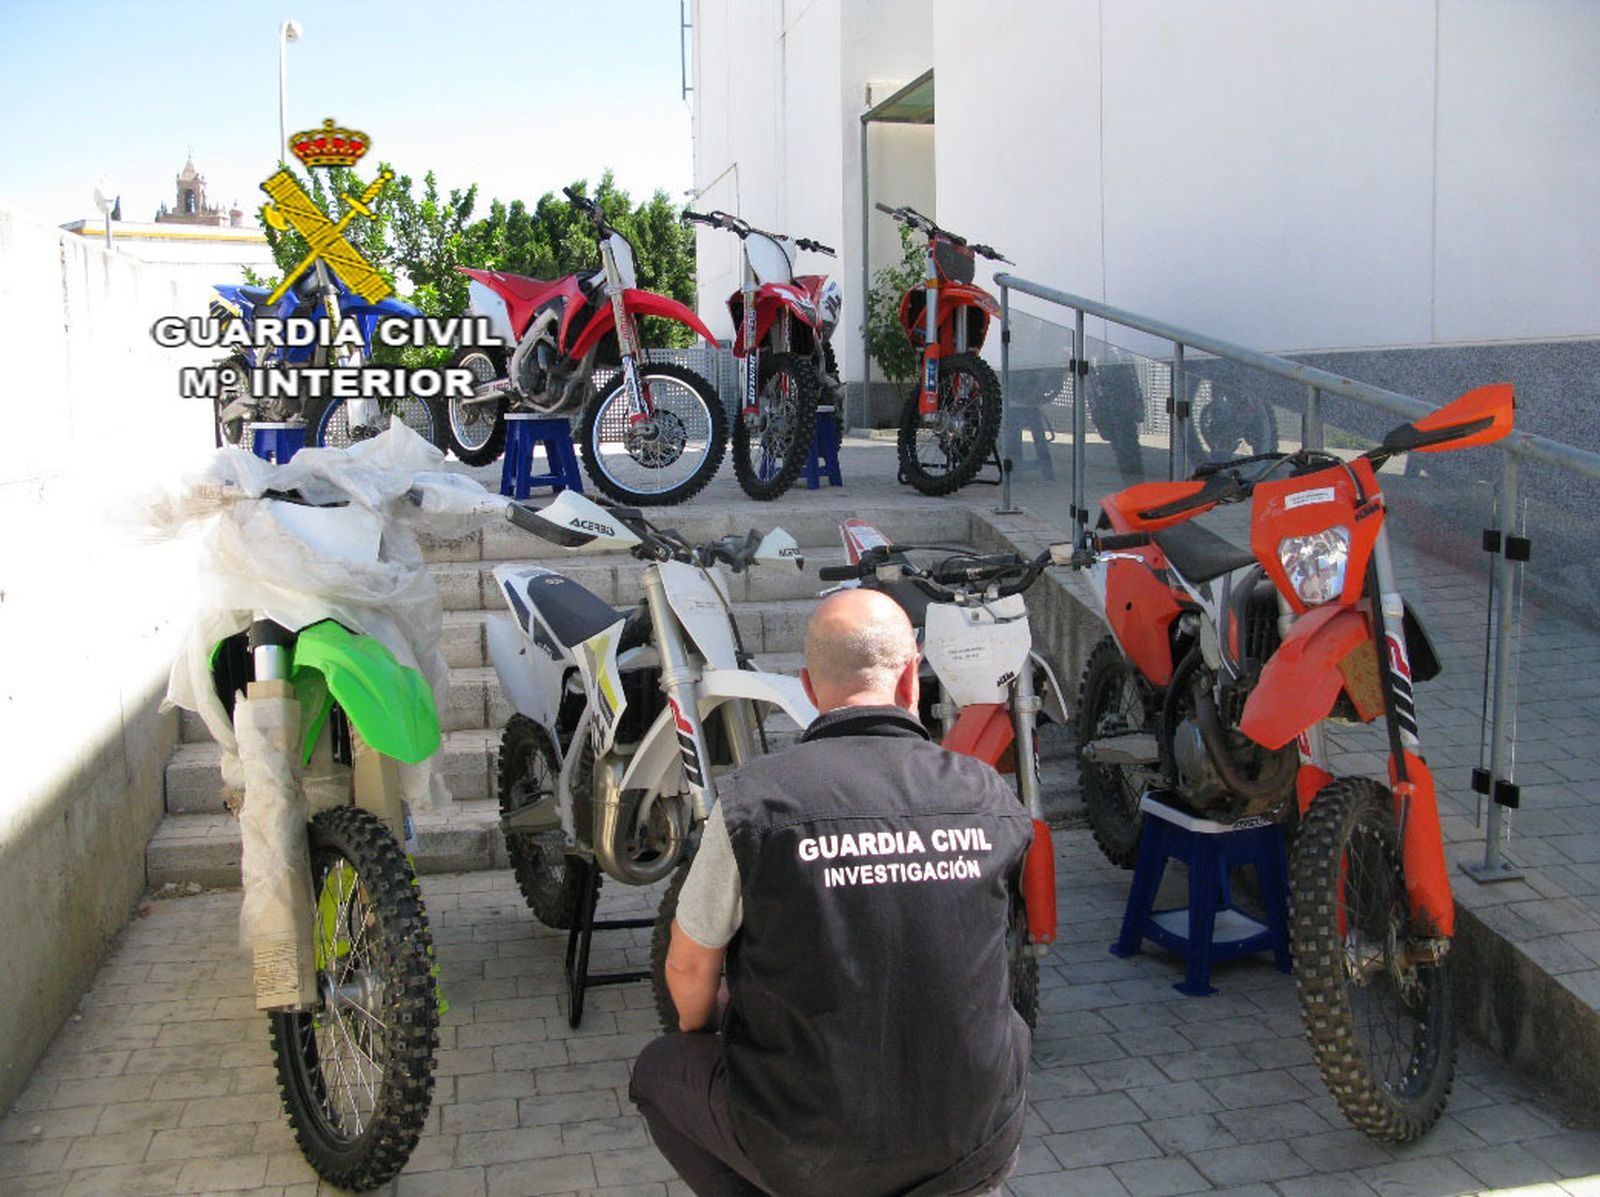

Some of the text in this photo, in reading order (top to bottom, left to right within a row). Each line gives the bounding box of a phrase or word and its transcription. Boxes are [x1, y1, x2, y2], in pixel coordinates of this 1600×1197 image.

[798, 827, 993, 862] GUARDIA CIVIL
[824, 856, 982, 888] INVESTIGACIÓN
